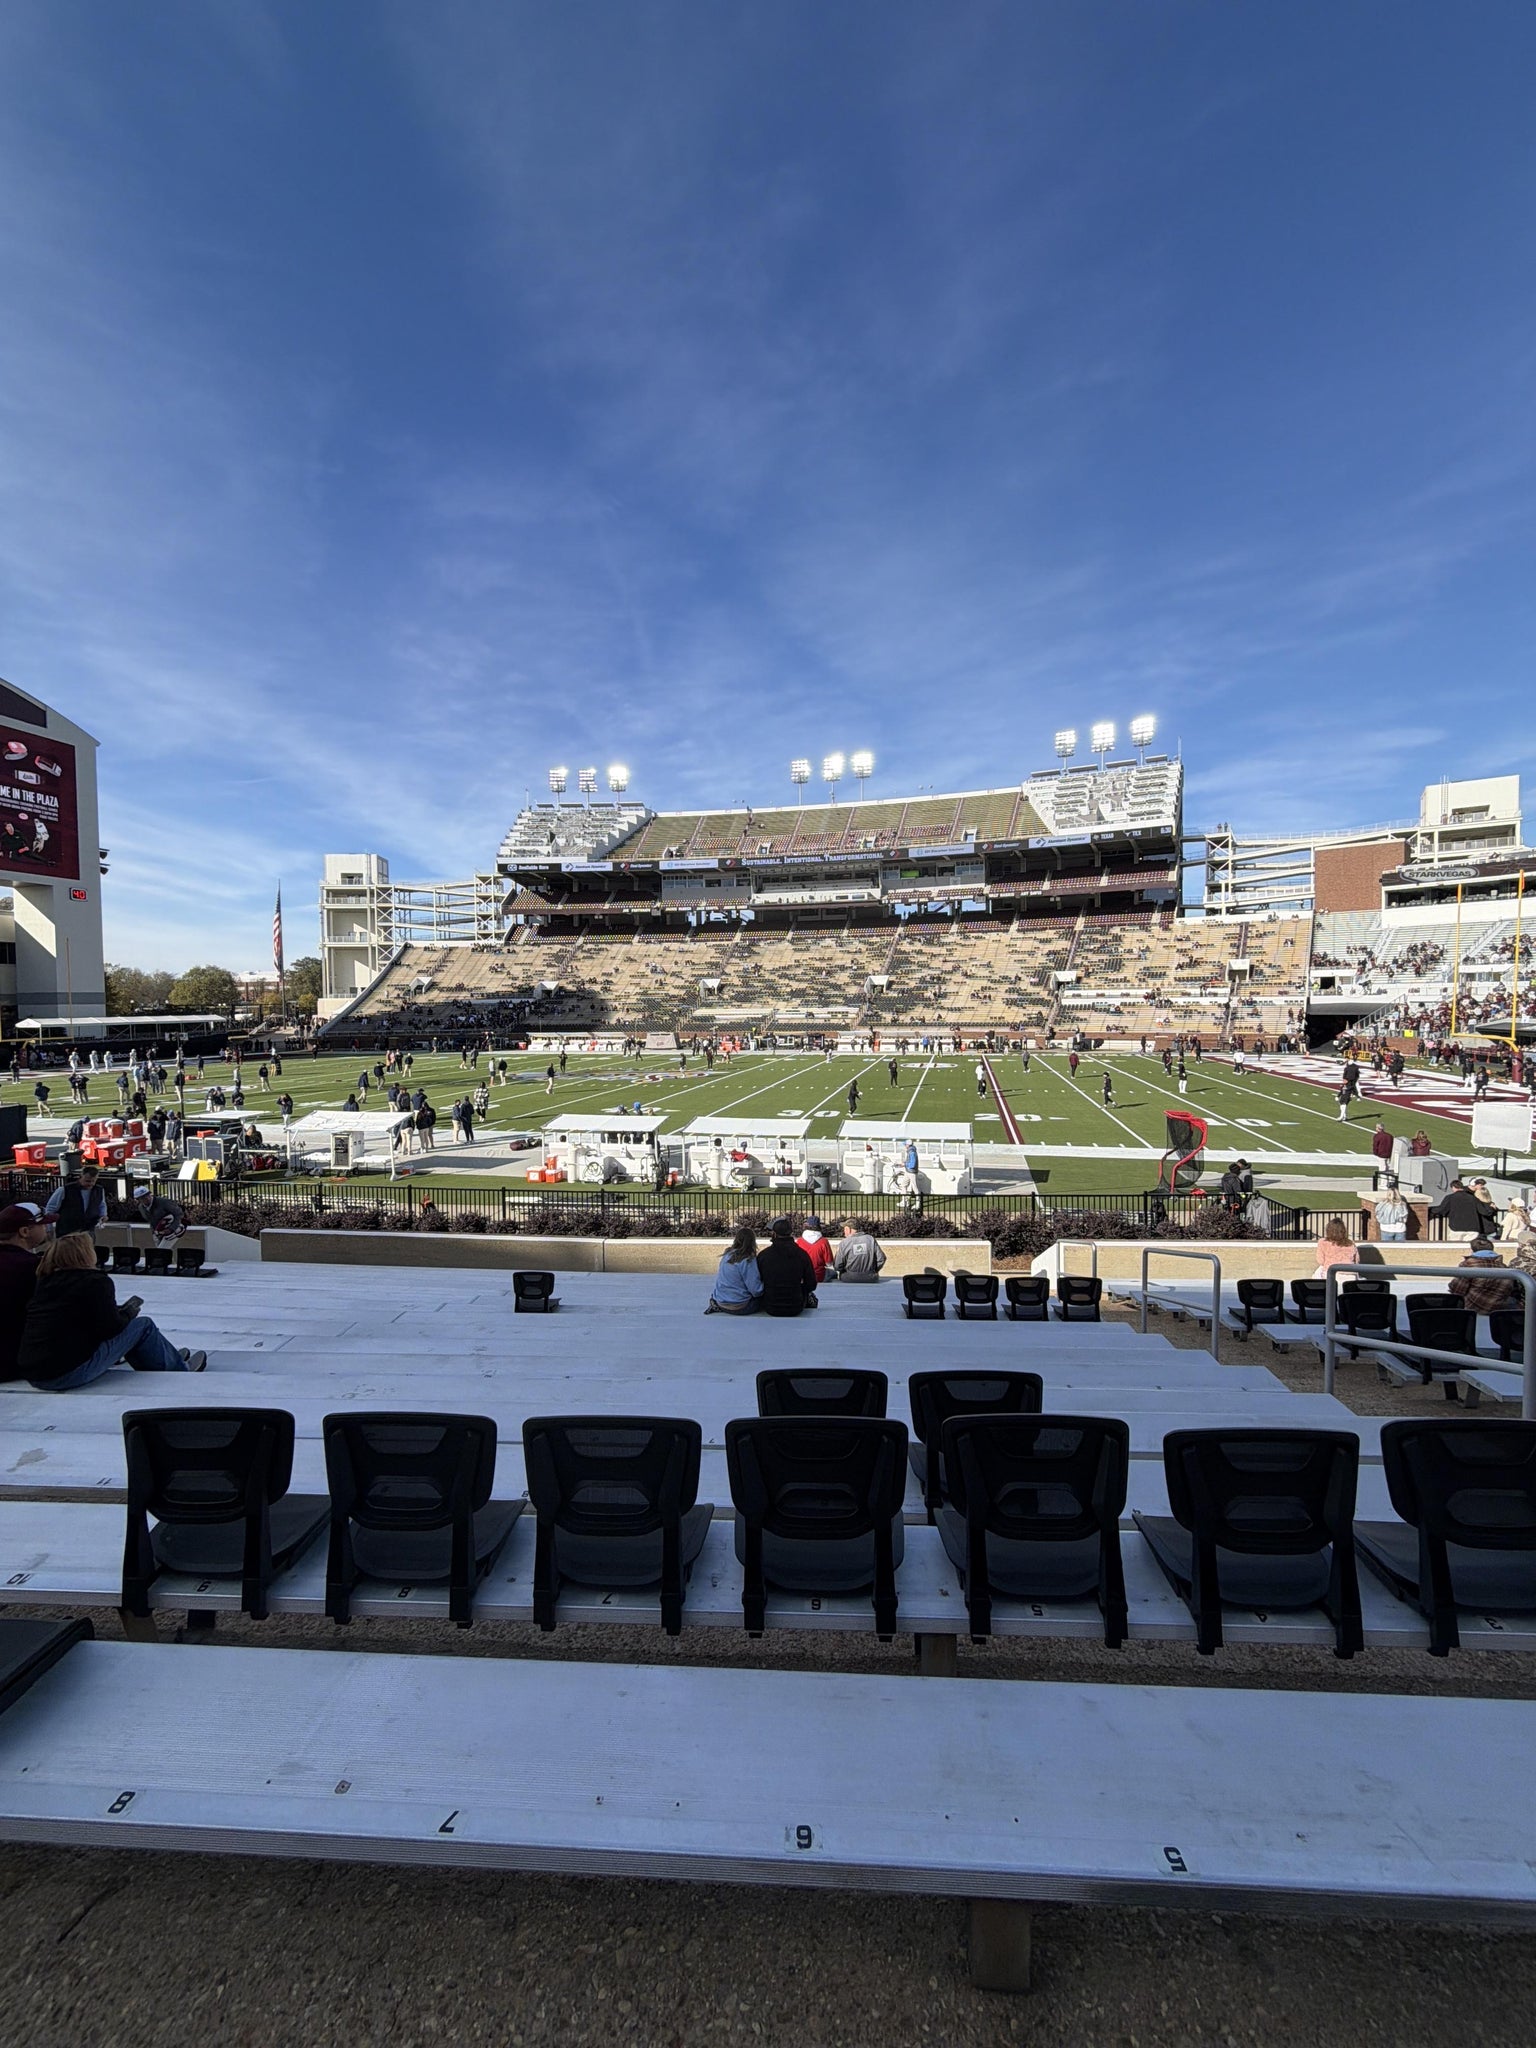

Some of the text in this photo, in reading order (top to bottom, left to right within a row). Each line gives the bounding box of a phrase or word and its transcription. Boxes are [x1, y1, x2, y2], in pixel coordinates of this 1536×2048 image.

[12, 787, 20, 800] IN
[21, 789, 36, 803] THE
[36, 792, 59, 808] PLAZA
[824, 852, 884, 862] TRANSFORMATIONAL
[1408, 867, 1471, 878] STARKVEGAS
[34, 1148, 44, 1160] G
[113, 1148, 125, 1160] G
[398, 1586, 411, 1597] 8
[107, 1790, 137, 1814] 8
[1162, 1845, 1187, 1873] 5
